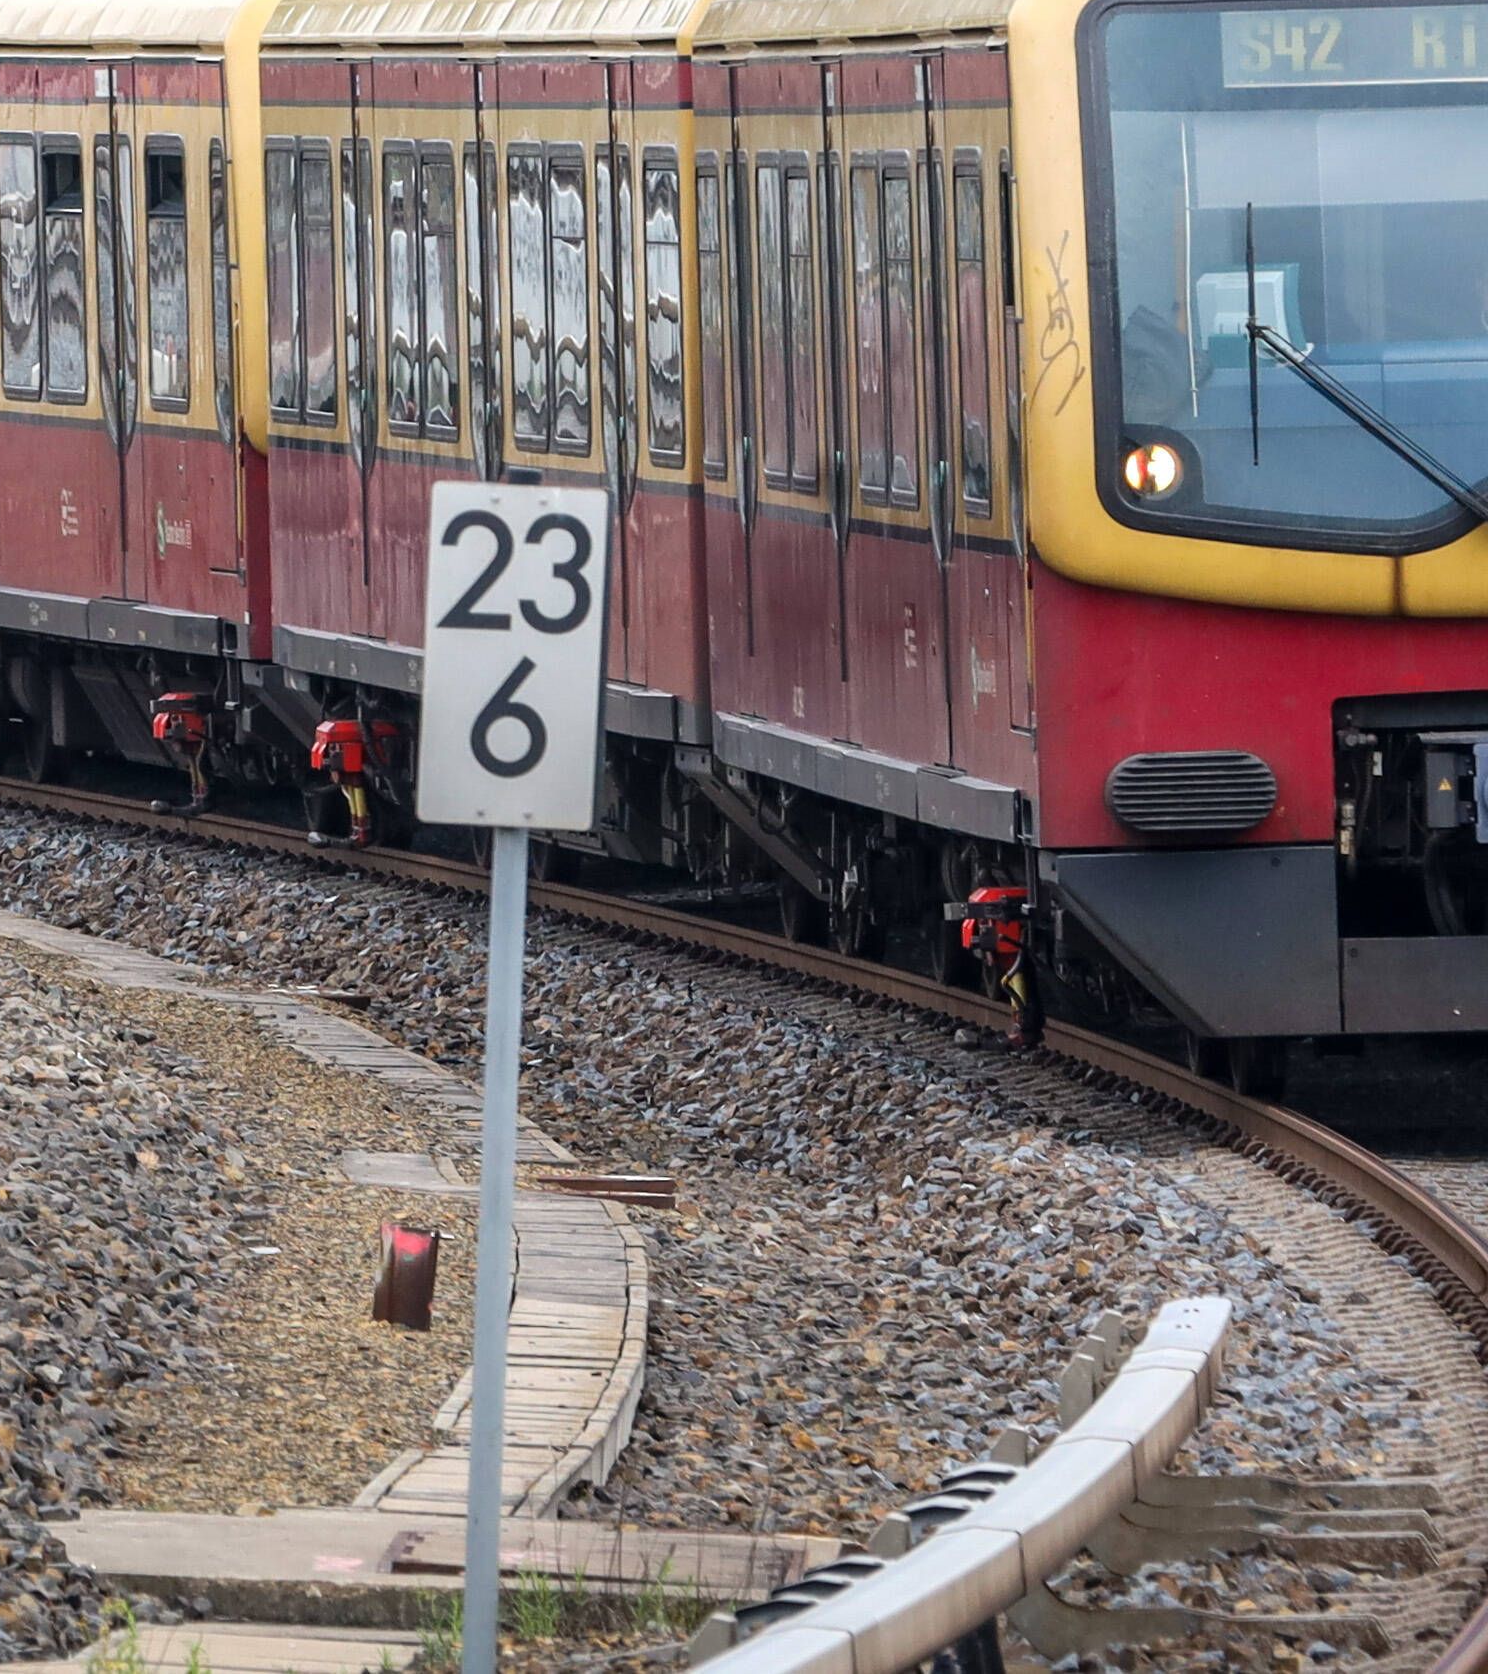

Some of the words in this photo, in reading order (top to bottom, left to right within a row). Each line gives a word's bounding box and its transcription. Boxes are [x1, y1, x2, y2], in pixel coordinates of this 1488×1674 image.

[1238, 16, 1344, 73] S42
[435, 509, 592, 635] 23
[470, 655, 548, 778] 6
